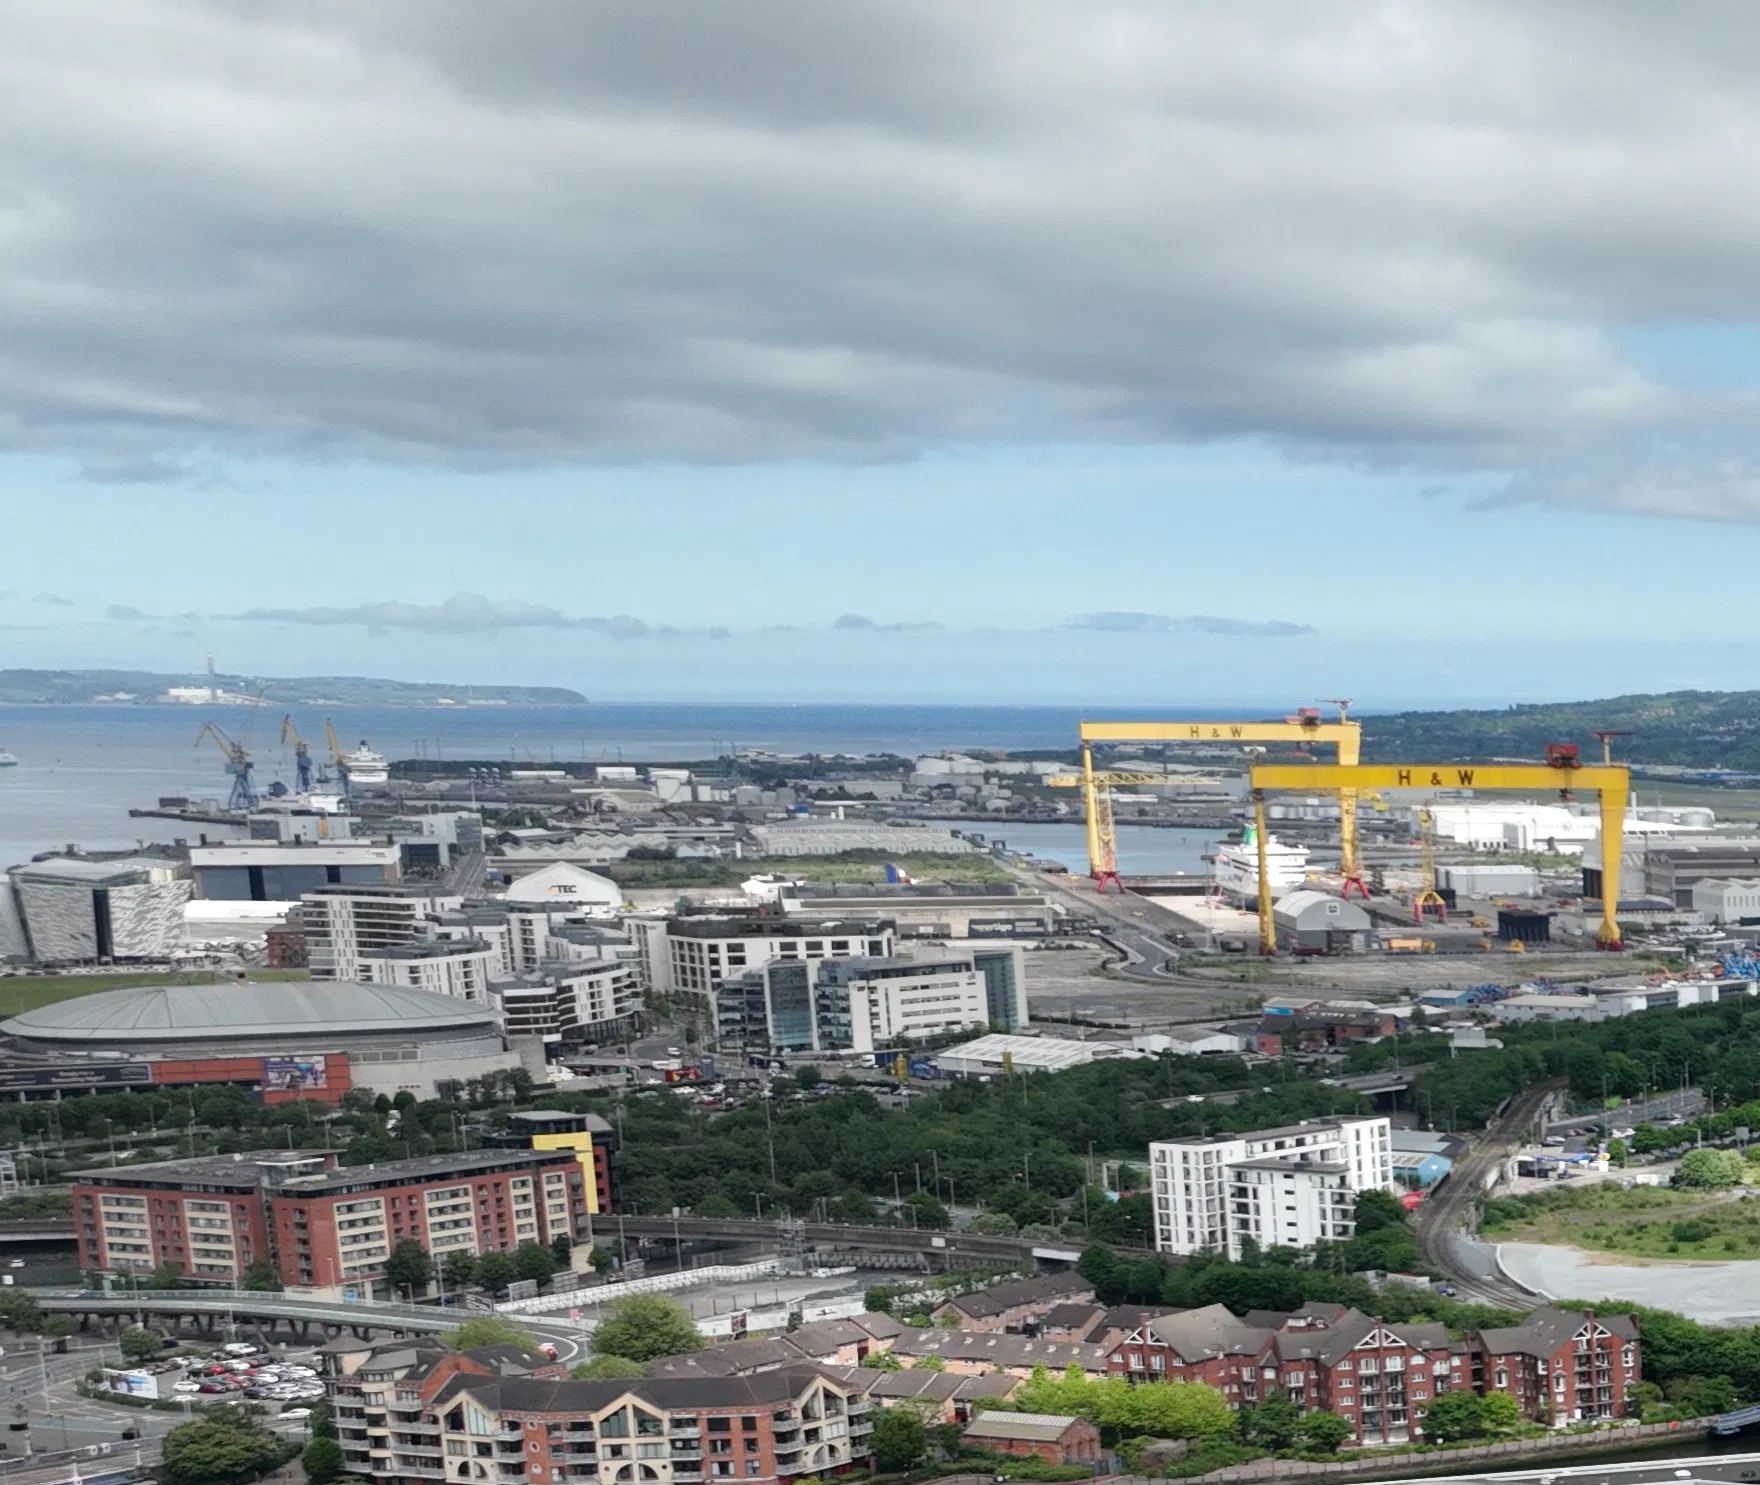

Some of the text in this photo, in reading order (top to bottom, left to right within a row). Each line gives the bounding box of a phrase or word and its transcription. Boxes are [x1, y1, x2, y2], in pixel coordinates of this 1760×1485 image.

[1190, 725, 1243, 738] H & W
[1398, 769, 1474, 786] H & W
